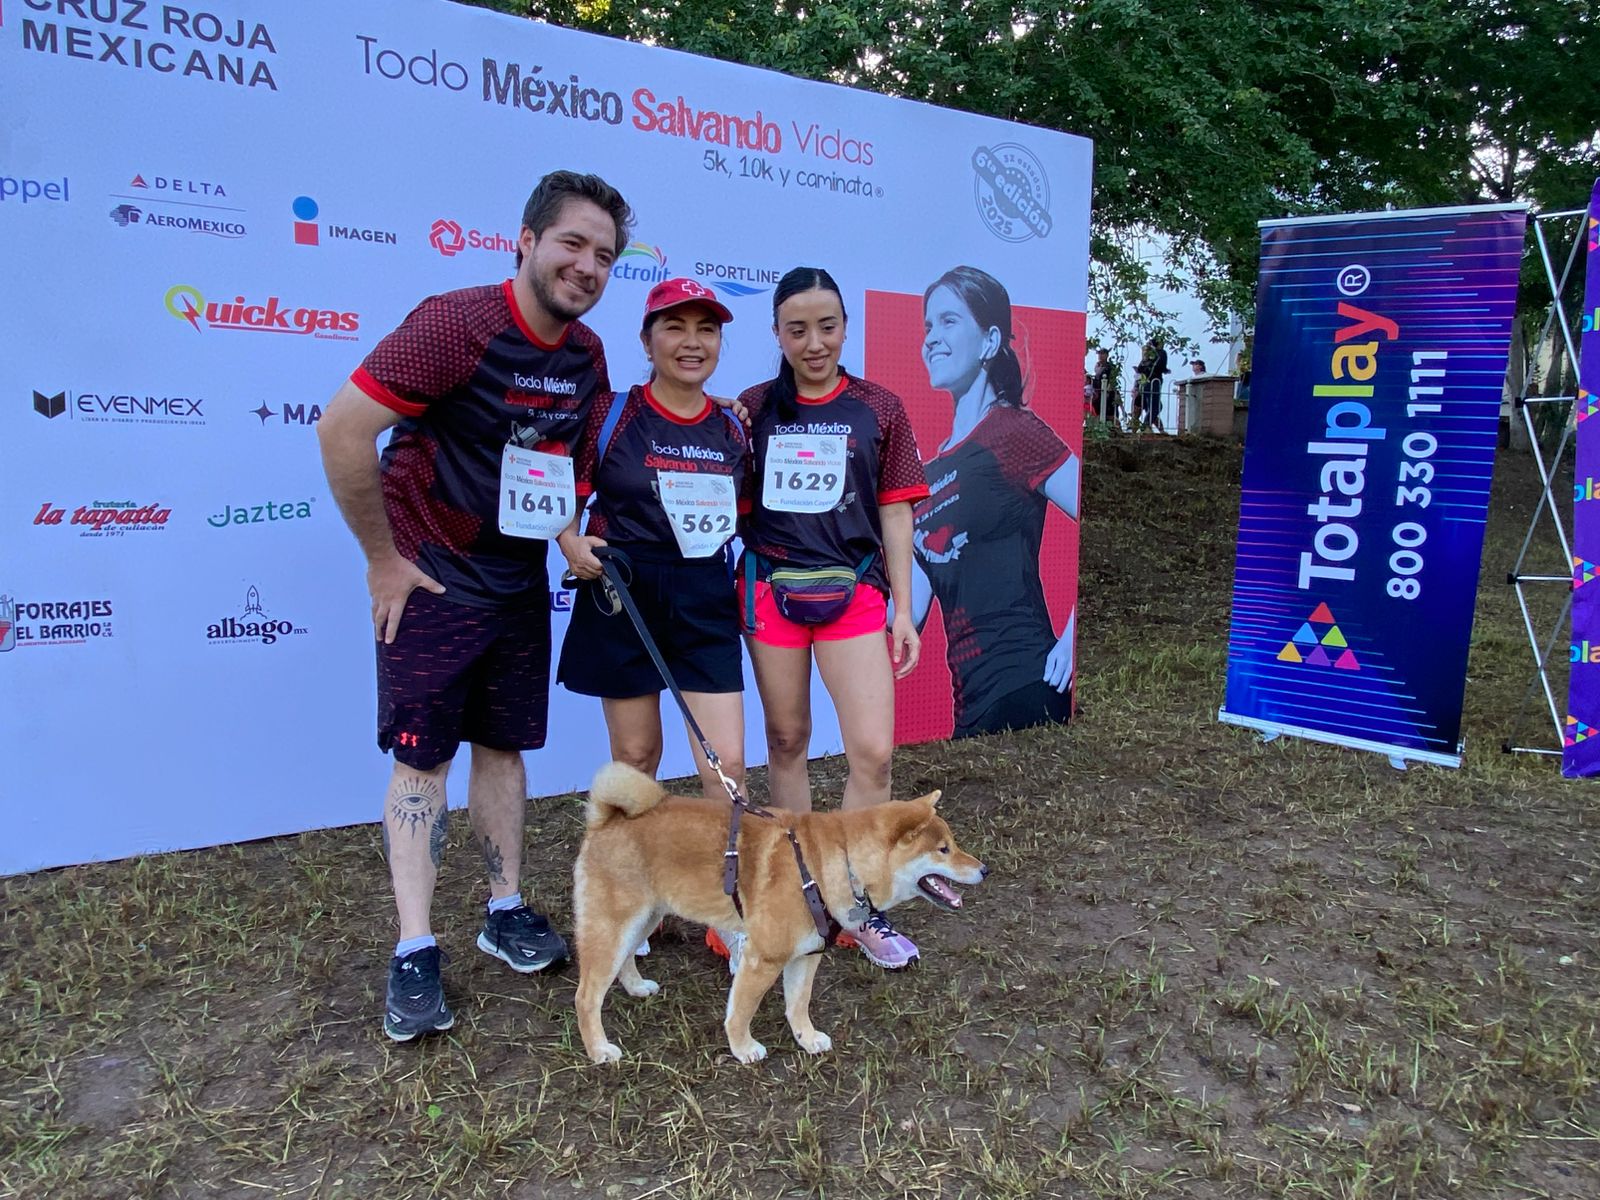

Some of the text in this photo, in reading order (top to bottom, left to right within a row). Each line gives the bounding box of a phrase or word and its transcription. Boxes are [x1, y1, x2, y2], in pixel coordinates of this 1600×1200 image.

[162, 5, 278, 53] ROJA
[22, 18, 278, 91] MEXICANA
[356, 34, 874, 166] Todo México Salvando Vidas
[703, 150, 733, 179] 5k,
[739, 155, 774, 182] 10k
[779, 168, 791, 188] y
[155, 177, 226, 197] DELTA
[981, 194, 1013, 235] 2025
[994, 173, 1049, 238] edición
[329, 225, 397, 244] IMAGEN
[609, 263, 672, 283] ctrolit
[695, 262, 781, 284] SPORTLINE
[514, 373, 577, 396] Todo México
[77, 394, 204, 416] EVENMEX
[283, 403, 323, 425] MA
[775, 421, 852, 434] Todo México
[644, 454, 699, 472] Salvando
[682, 445, 725, 462] México
[773, 470, 838, 491] 1629
[1386, 351, 1449, 600] 800 330 1111
[207, 500, 311, 527] Jaztea
[508, 489, 567, 517] 1641
[33, 502, 172, 530] la tapatía
[671, 513, 731, 534] 562
[15, 600, 112, 622] FORRAJES
[17, 622, 101, 640] EL BARRIO
[206, 616, 309, 645] albago mx
